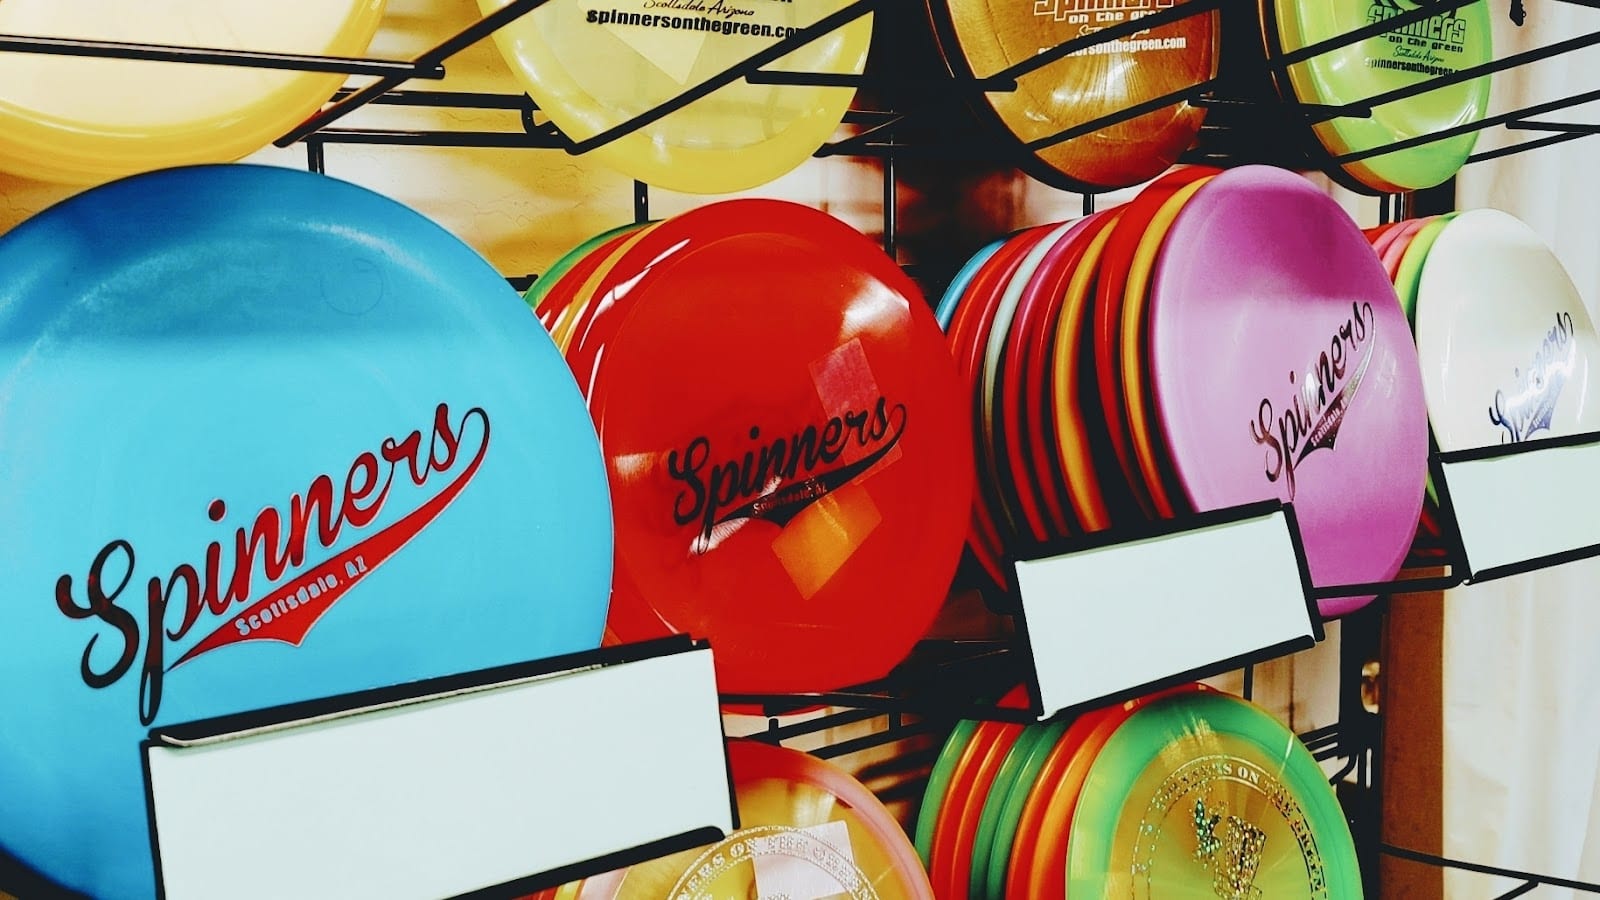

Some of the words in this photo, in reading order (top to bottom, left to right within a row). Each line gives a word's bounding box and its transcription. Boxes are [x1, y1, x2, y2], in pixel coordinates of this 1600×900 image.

[586, 9, 806, 39] spinnersonthegreen.co
[1068, 12, 1089, 24] on
[1095, 11, 1124, 22] the
[1388, 35, 1403, 43] on
[1407, 38, 1427, 47] the
[1431, 41, 1463, 53] green
[1251, 301, 1376, 501] Spinners
[668, 396, 907, 556] Spinners
[55, 402, 491, 726] Spinners
[1237, 766, 1260, 785] ON
